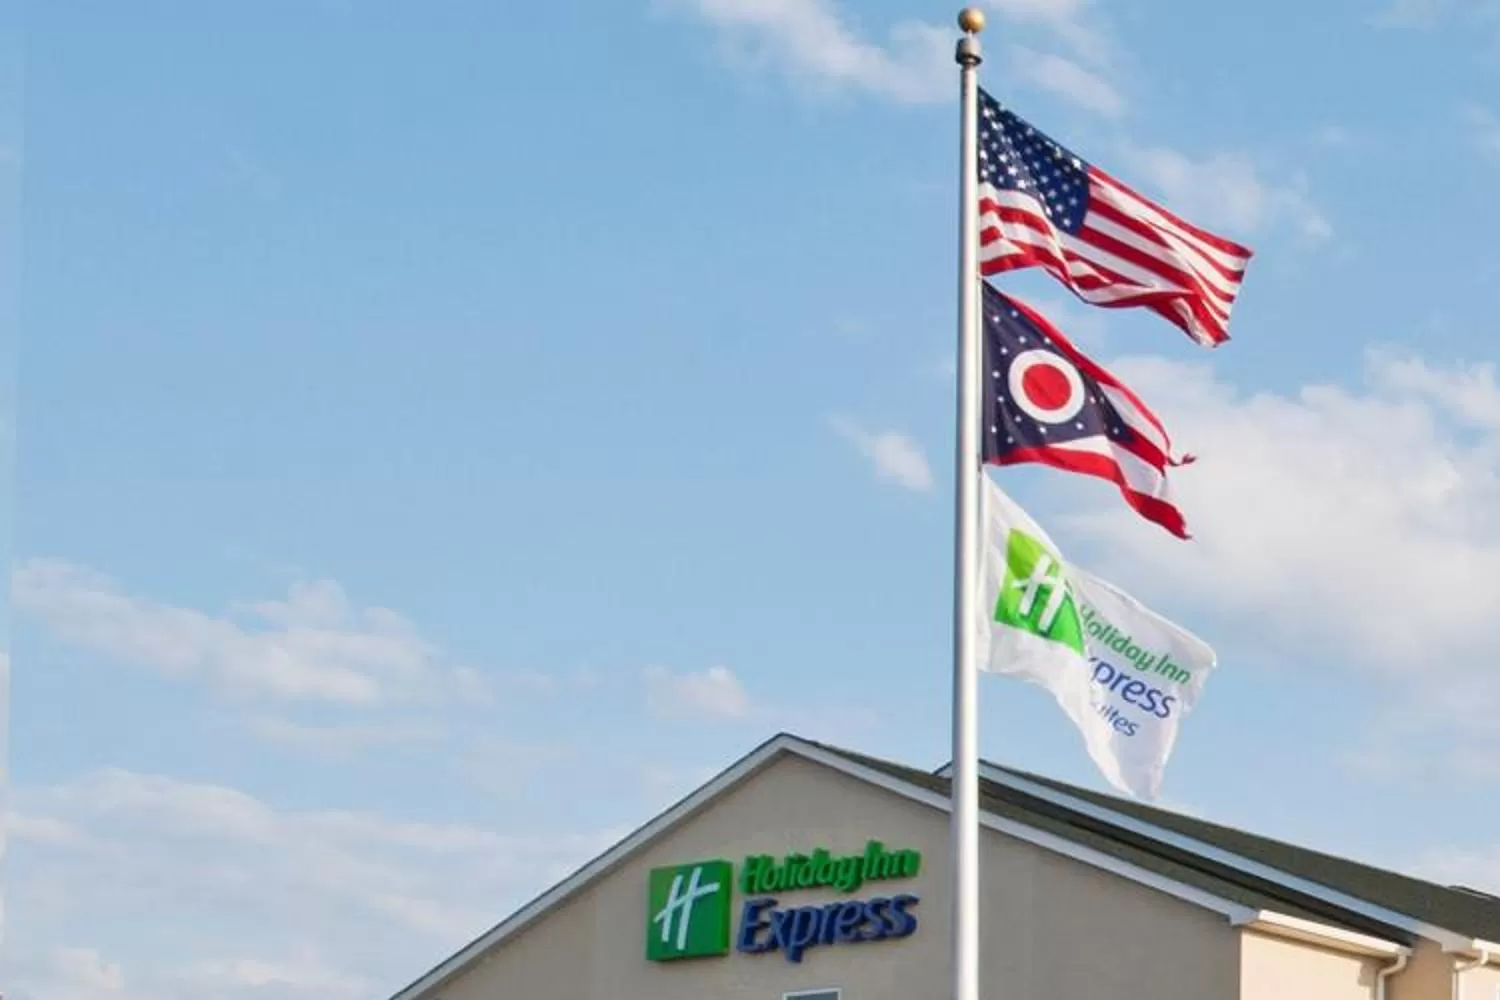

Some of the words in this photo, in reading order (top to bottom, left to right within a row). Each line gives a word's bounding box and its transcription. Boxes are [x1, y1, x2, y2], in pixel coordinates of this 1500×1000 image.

[1088, 657, 1176, 719] press
[1154, 654, 1191, 684] Inn
[738, 848, 864, 893] Holiday
[862, 839, 920, 881] Inn
[653, 866, 720, 950] H
[736, 893, 920, 963] Express
